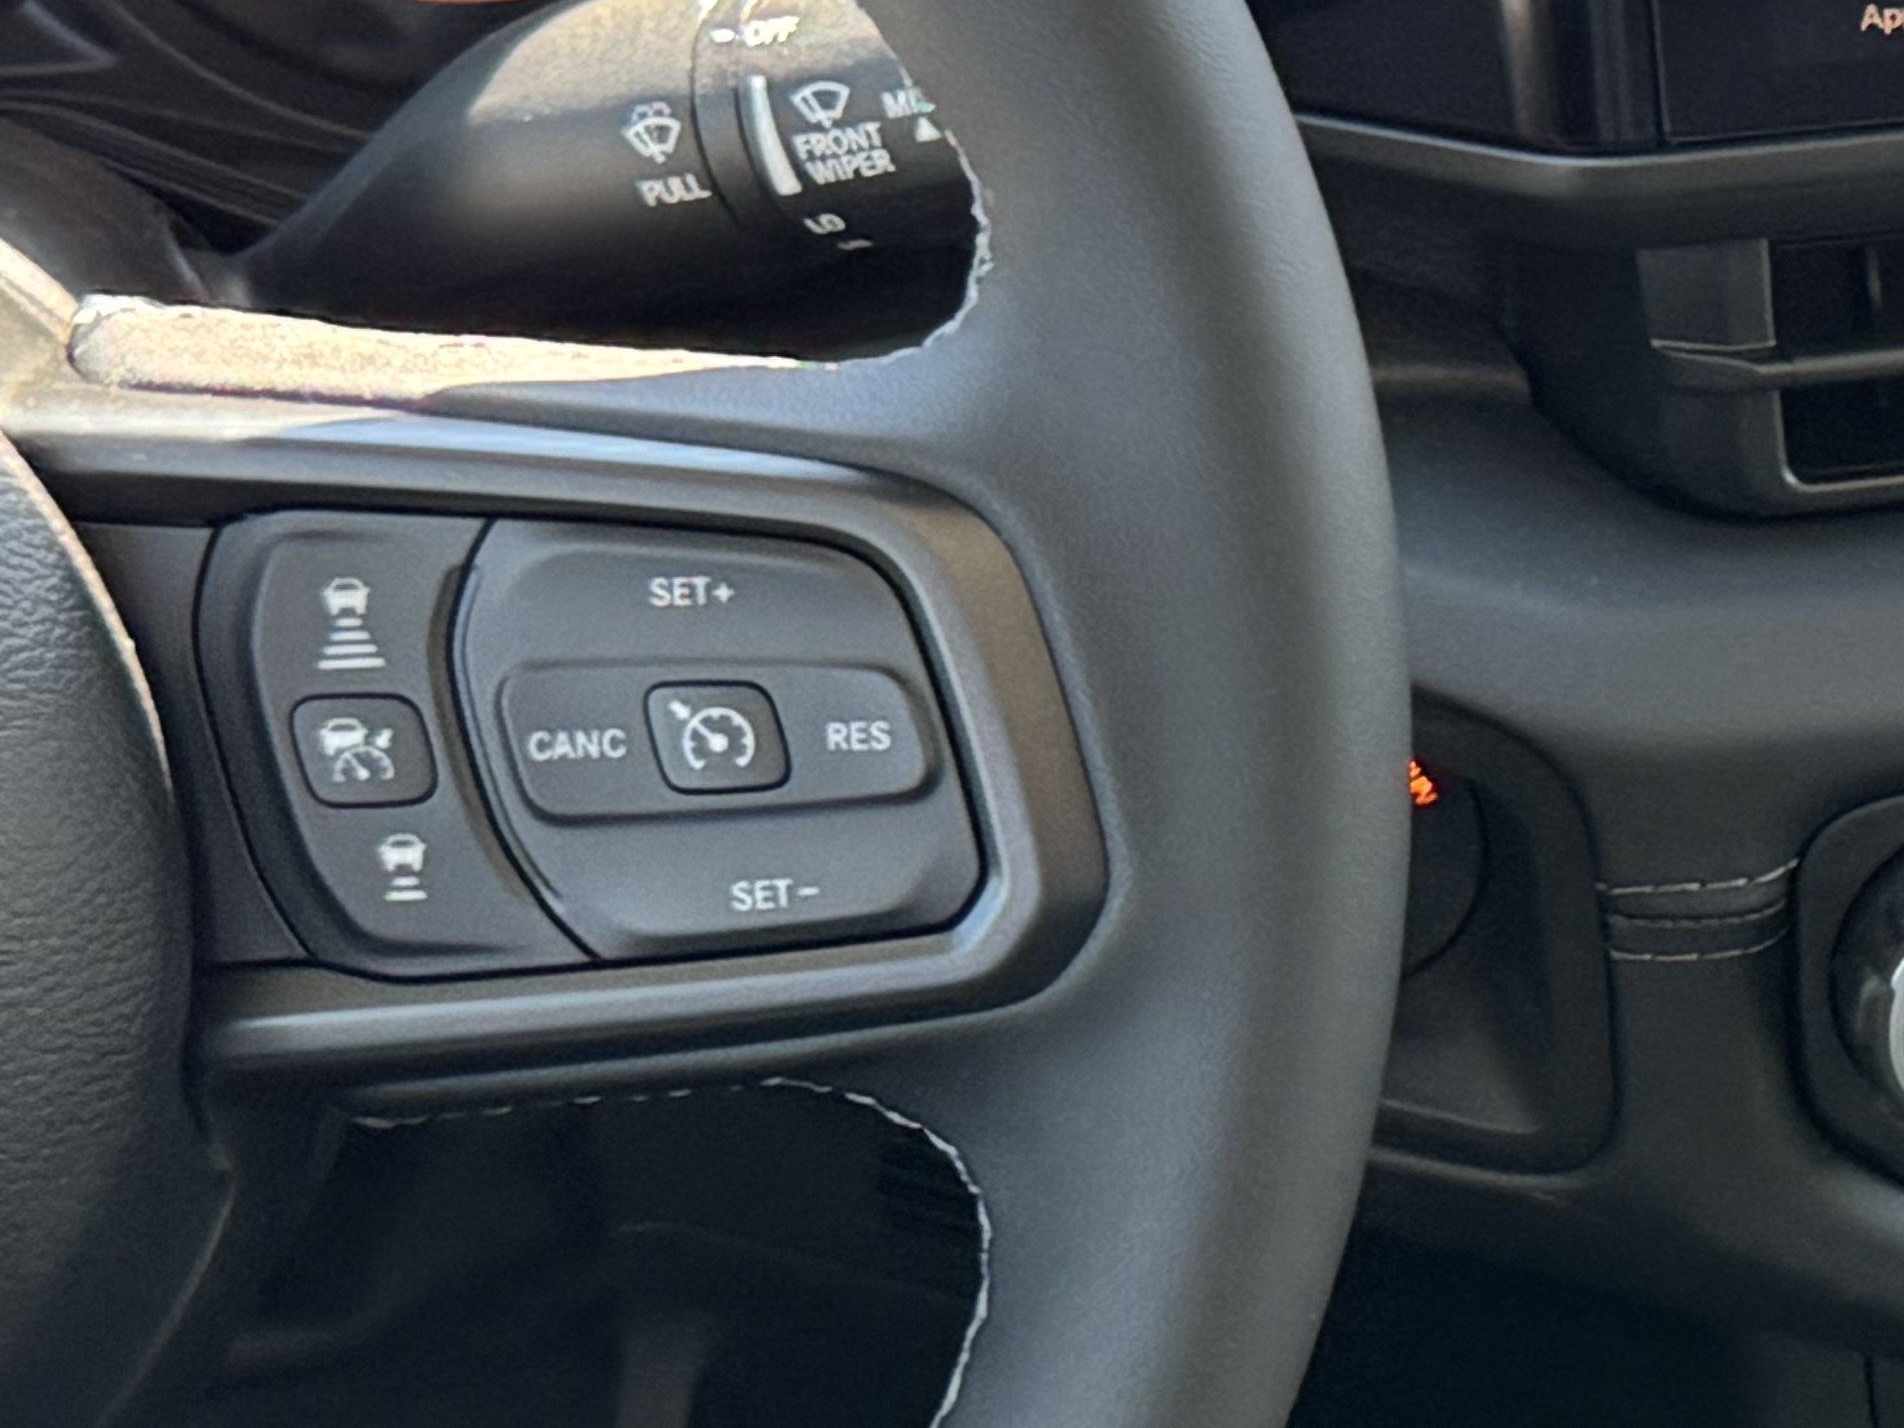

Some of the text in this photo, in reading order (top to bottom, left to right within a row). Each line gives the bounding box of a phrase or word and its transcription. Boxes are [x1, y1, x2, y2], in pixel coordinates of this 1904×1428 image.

[744, 17, 799, 46] OFF
[793, 121, 882, 160] FRONT
[804, 148, 896, 185] WIPER
[637, 174, 711, 205] PULL
[650, 576, 734, 608] SET+
[528, 728, 627, 762] CANC
[826, 721, 891, 752] RES
